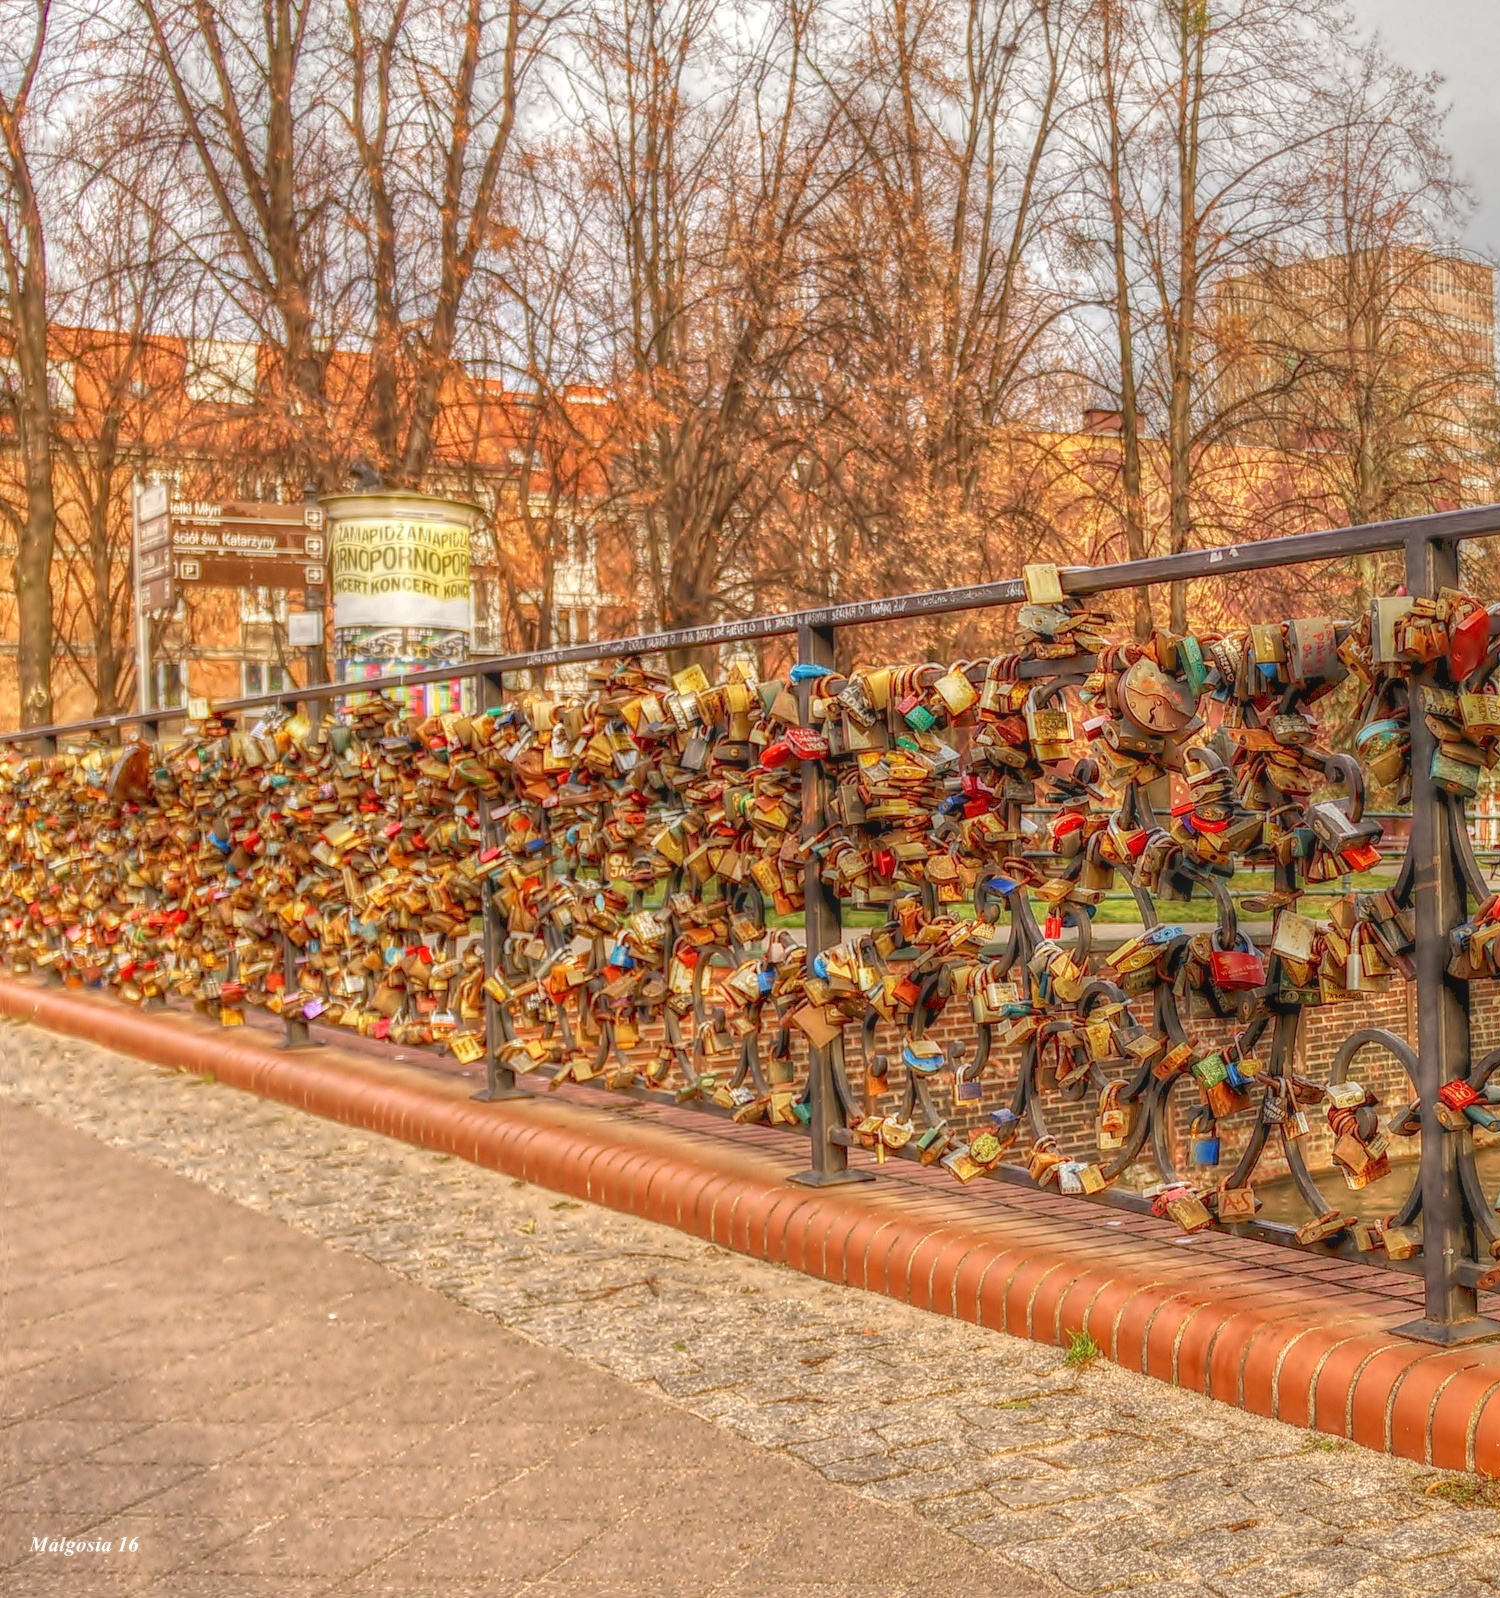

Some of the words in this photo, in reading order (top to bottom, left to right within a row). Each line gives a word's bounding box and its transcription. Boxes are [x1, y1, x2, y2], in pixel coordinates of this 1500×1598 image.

[170, 502, 193, 515] ielki
[173, 531, 199, 544] ściół
[222, 533, 277, 549] Katarzyny
[370, 576, 439, 597] KONCERT
